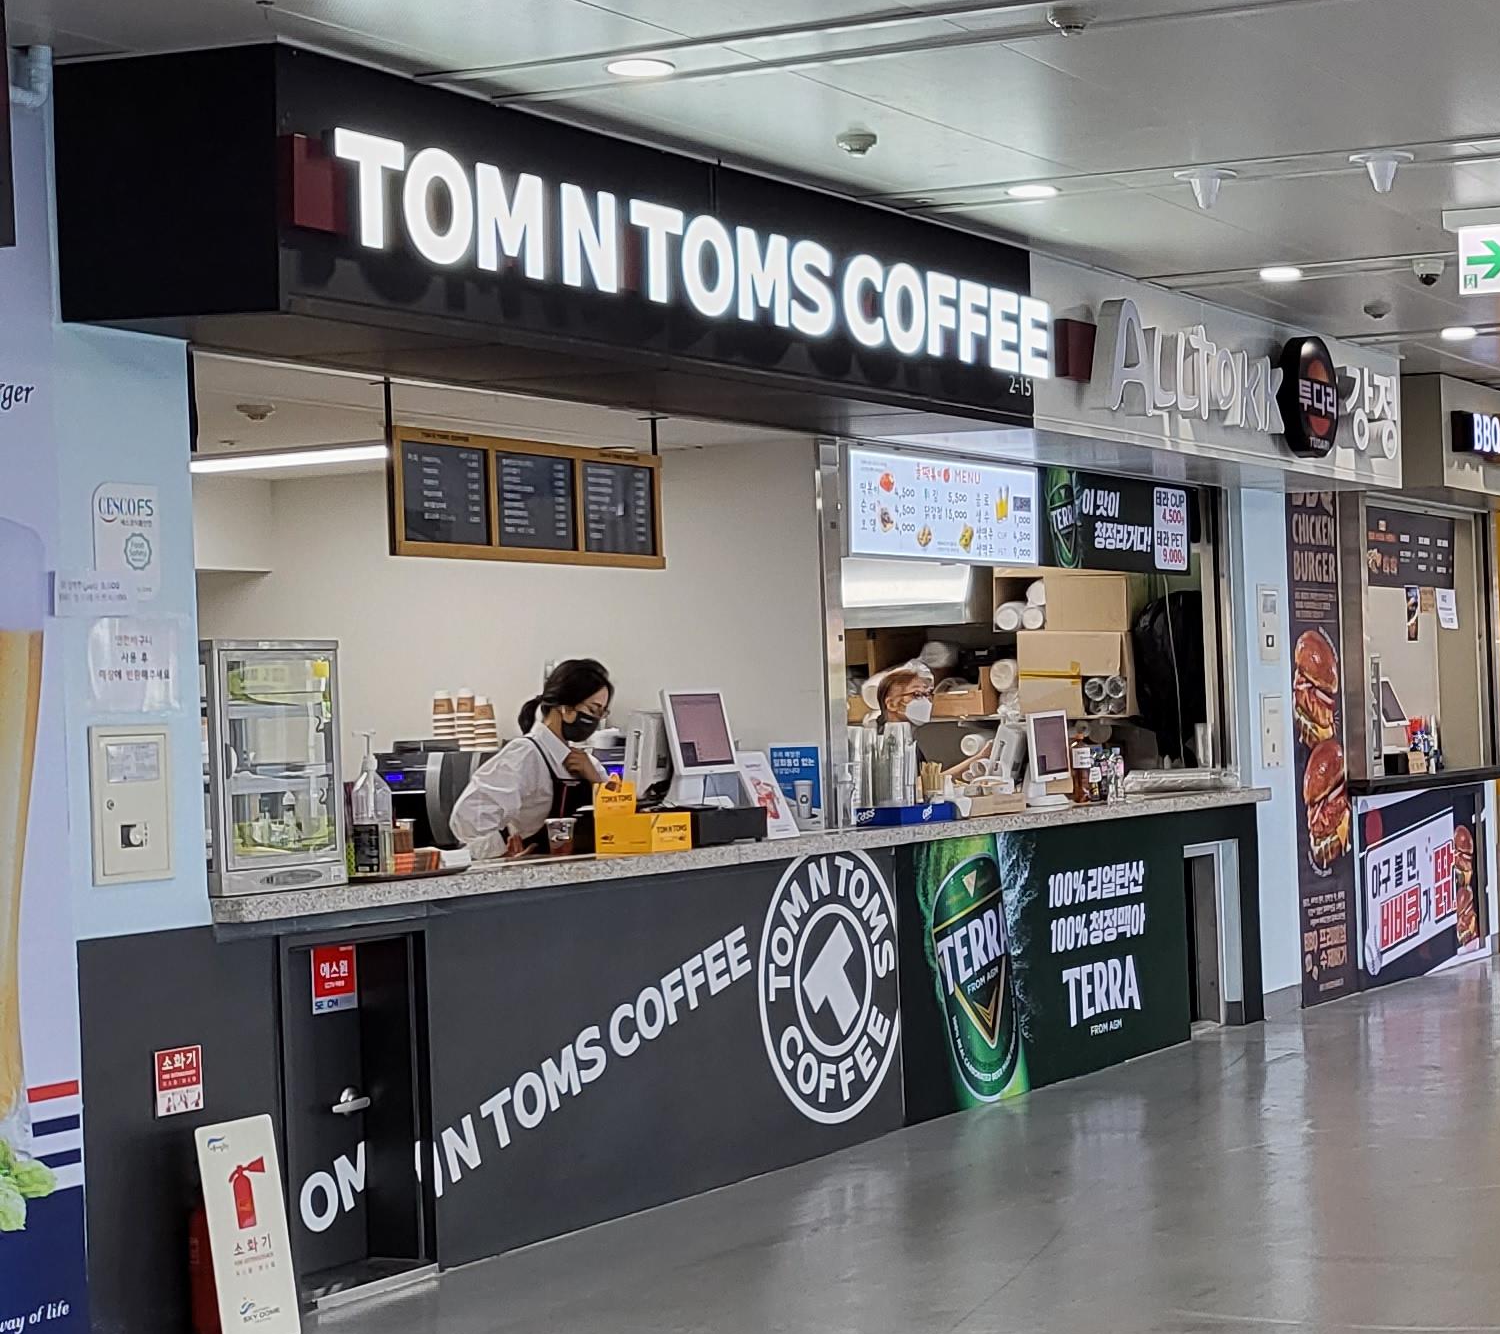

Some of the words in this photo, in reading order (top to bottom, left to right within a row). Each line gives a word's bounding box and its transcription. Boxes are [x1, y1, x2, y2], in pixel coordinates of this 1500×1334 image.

[334, 126, 544, 280] TOM
[559, 182, 618, 294] N
[629, 198, 836, 336] TOMS
[842, 253, 1049, 379] COFFEE
[0, 383, 35, 410] ger
[1009, 375, 1031, 396] 2-15
[1298, 378, 1337, 420] 투다리
[1346, 366, 1398, 460] 강정
[954, 470, 981, 485] MENU
[1081, 488, 1095, 516] 이
[1096, 491, 1120, 518] 맛이
[1170, 492, 1185, 508] CUP
[1094, 521, 1152, 554] 청정라거다!
[1171, 534, 1184, 548] PET
[1292, 513, 1335, 547] CHICKEN
[1294, 550, 1336, 583] BURGER
[1049, 868, 1086, 909] 100%
[1087, 860, 1145, 900] 리얼탄산
[1371, 858, 1391, 899] 야구
[769, 880, 810, 1001] TOM
[807, 856, 831, 902] N
[834, 855, 896, 979] TOMS
[1051, 913, 1088, 953] 100%
[1090, 902, 1145, 945] 청정맥아
[1380, 885, 1421, 951] 비비큐
[936, 902, 1010, 996] TERRA
[320, 959, 349, 979] 에스원
[967, 974, 987, 996] FROM
[1062, 954, 1142, 1028] TERRA
[1090, 1023, 1109, 1037] FROM
[161, 1050, 196, 1071] 소화기
[440, 1113, 482, 1183] N
[480, 1025, 607, 1149] TOMS
[609, 925, 752, 1058] COFFEE
[780, 1004, 891, 1104] COFFEE
[233, 1233, 273, 1256] 소화기
[29, 1305, 45, 1324] of
[46, 1299, 70, 1320] life
